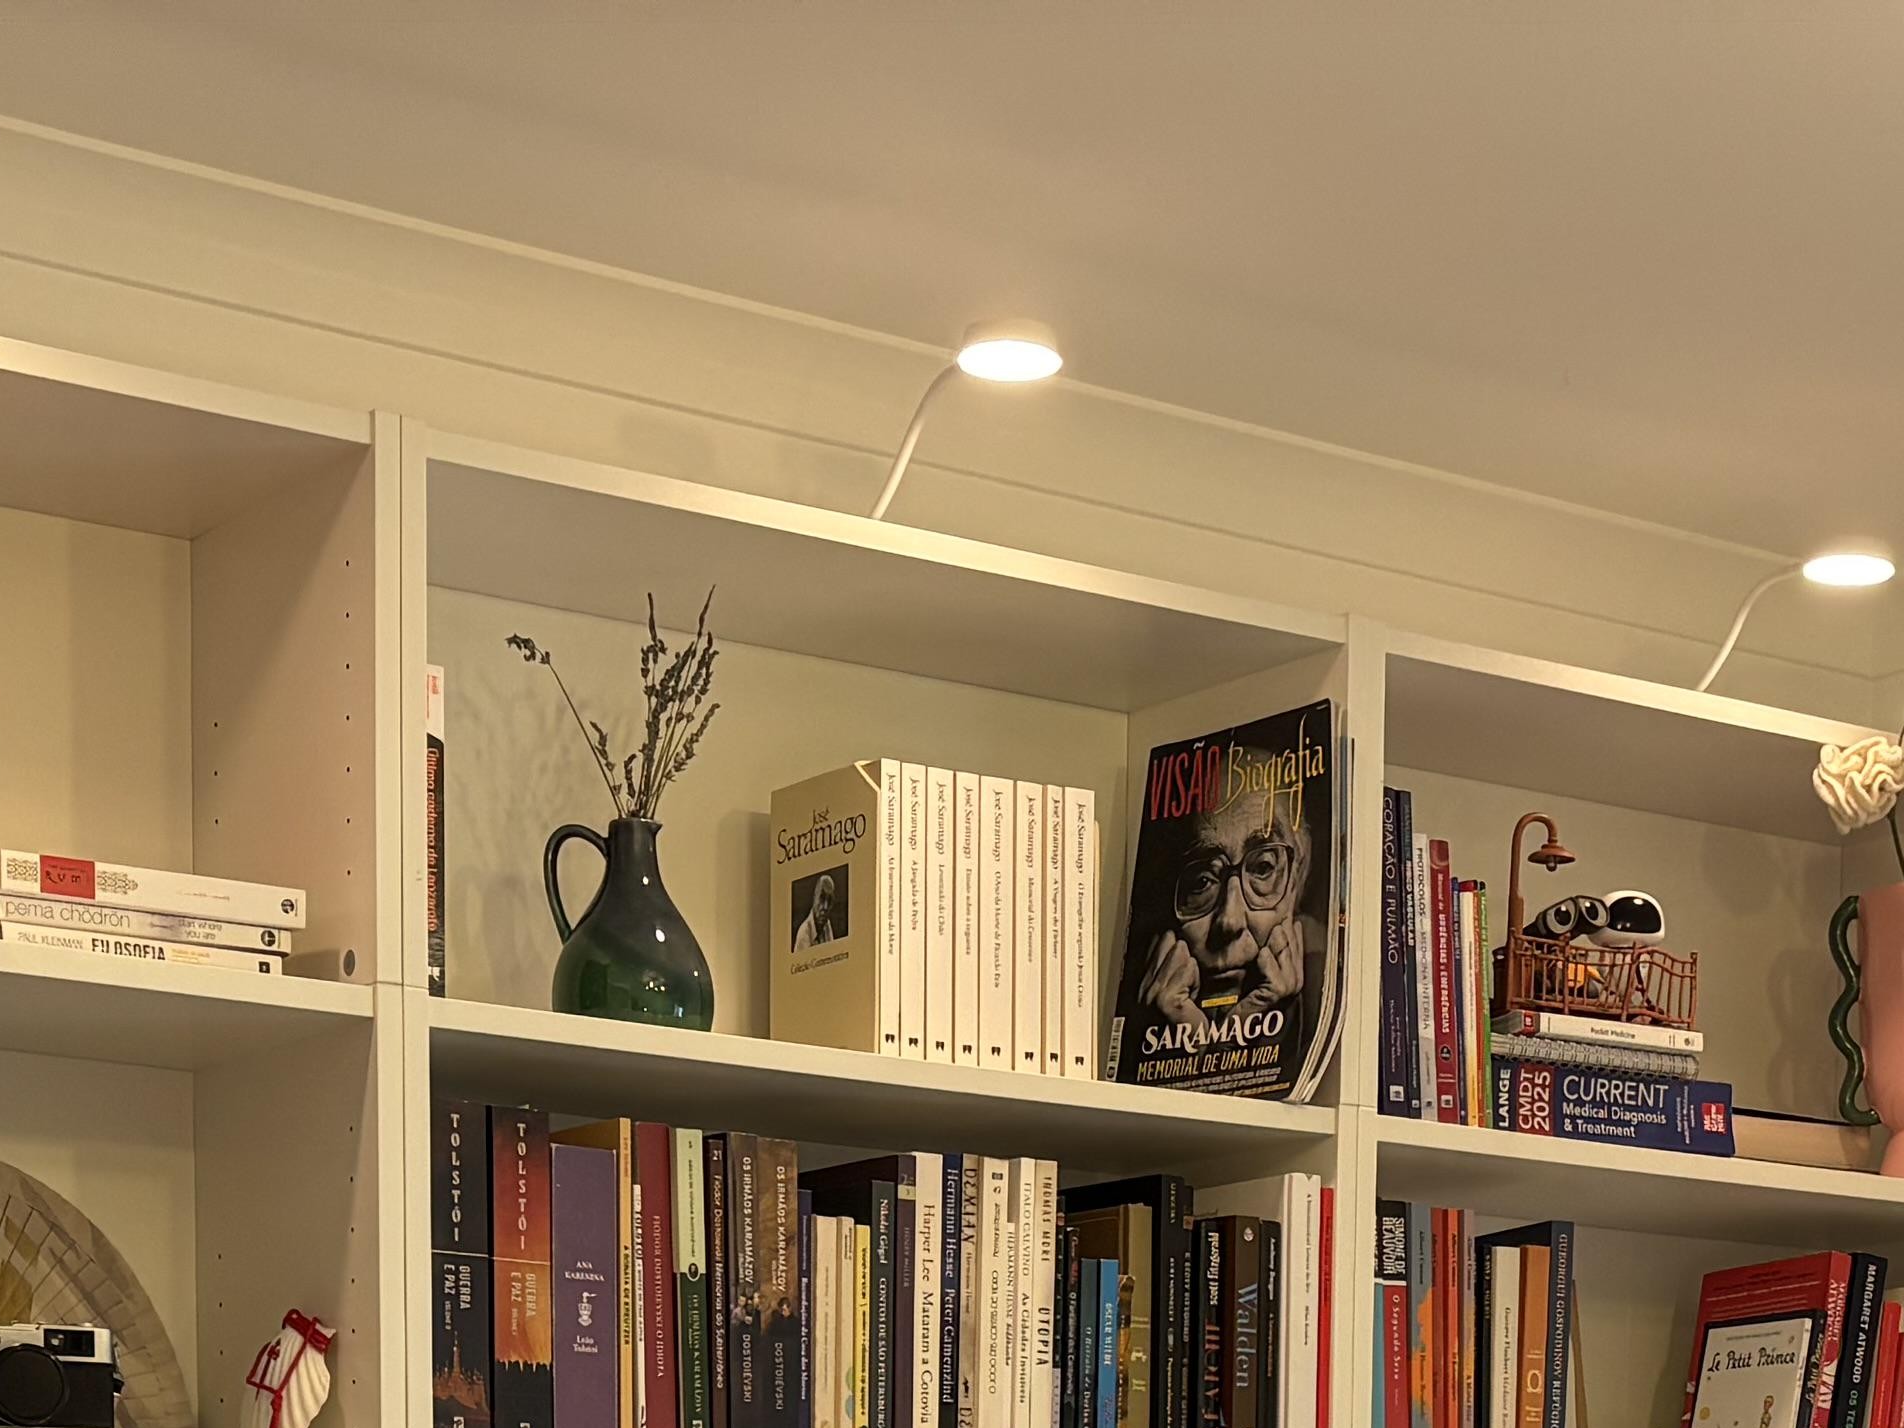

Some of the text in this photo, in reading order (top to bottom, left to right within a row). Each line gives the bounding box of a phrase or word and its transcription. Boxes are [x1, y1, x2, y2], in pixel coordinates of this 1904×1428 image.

[1150, 714, 1325, 837] VISÃO Biografia
[777, 814, 866, 864] Saramago
[1142, 1010, 1284, 1055] SARAMAGO
[1137, 1056, 1199, 1082] MEMORIAL
[1203, 1054, 1218, 1074] DE
[1220, 1049, 1247, 1071] UMA
[1252, 1046, 1279, 1067] VIDA
[1499, 1069, 1511, 1127] LANGE
[1519, 1069, 1532, 1129] CMDT
[1533, 1071, 1550, 1131] 2025
[1563, 1075, 1669, 1108] CURRENT
[1563, 1103, 1666, 1125] Medical Diagnosis
[1564, 1120, 1635, 1137] & Treatment
[449, 1113, 462, 1242] TOLSTÓI
[517, 1122, 527, 1251] TOLSTÓI
[459, 1265, 470, 1310] GUERRA
[1236, 1282, 1259, 1389] Walden
[1707, 1348, 1796, 1372] Le Petit Prince
